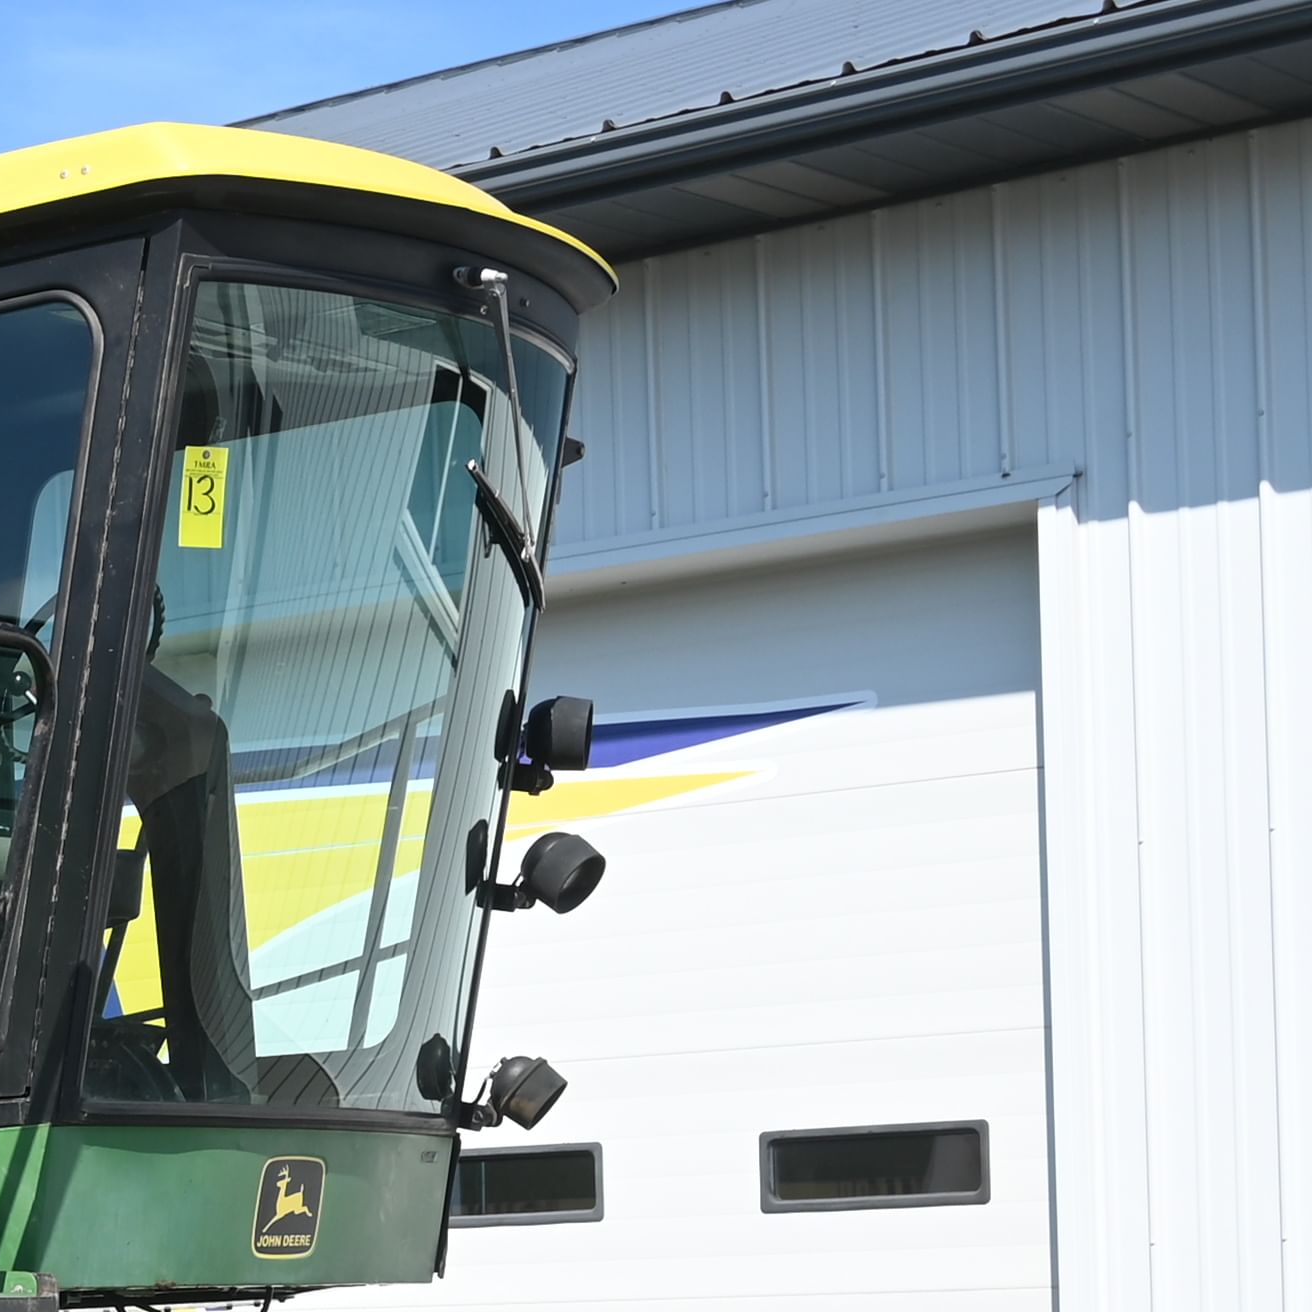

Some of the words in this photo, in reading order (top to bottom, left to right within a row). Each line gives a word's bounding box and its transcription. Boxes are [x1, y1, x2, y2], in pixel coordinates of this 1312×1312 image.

[187, 474, 216, 515] 13
[256, 1234, 282, 1248] JOHN
[282, 1234, 312, 1247] DEERE
